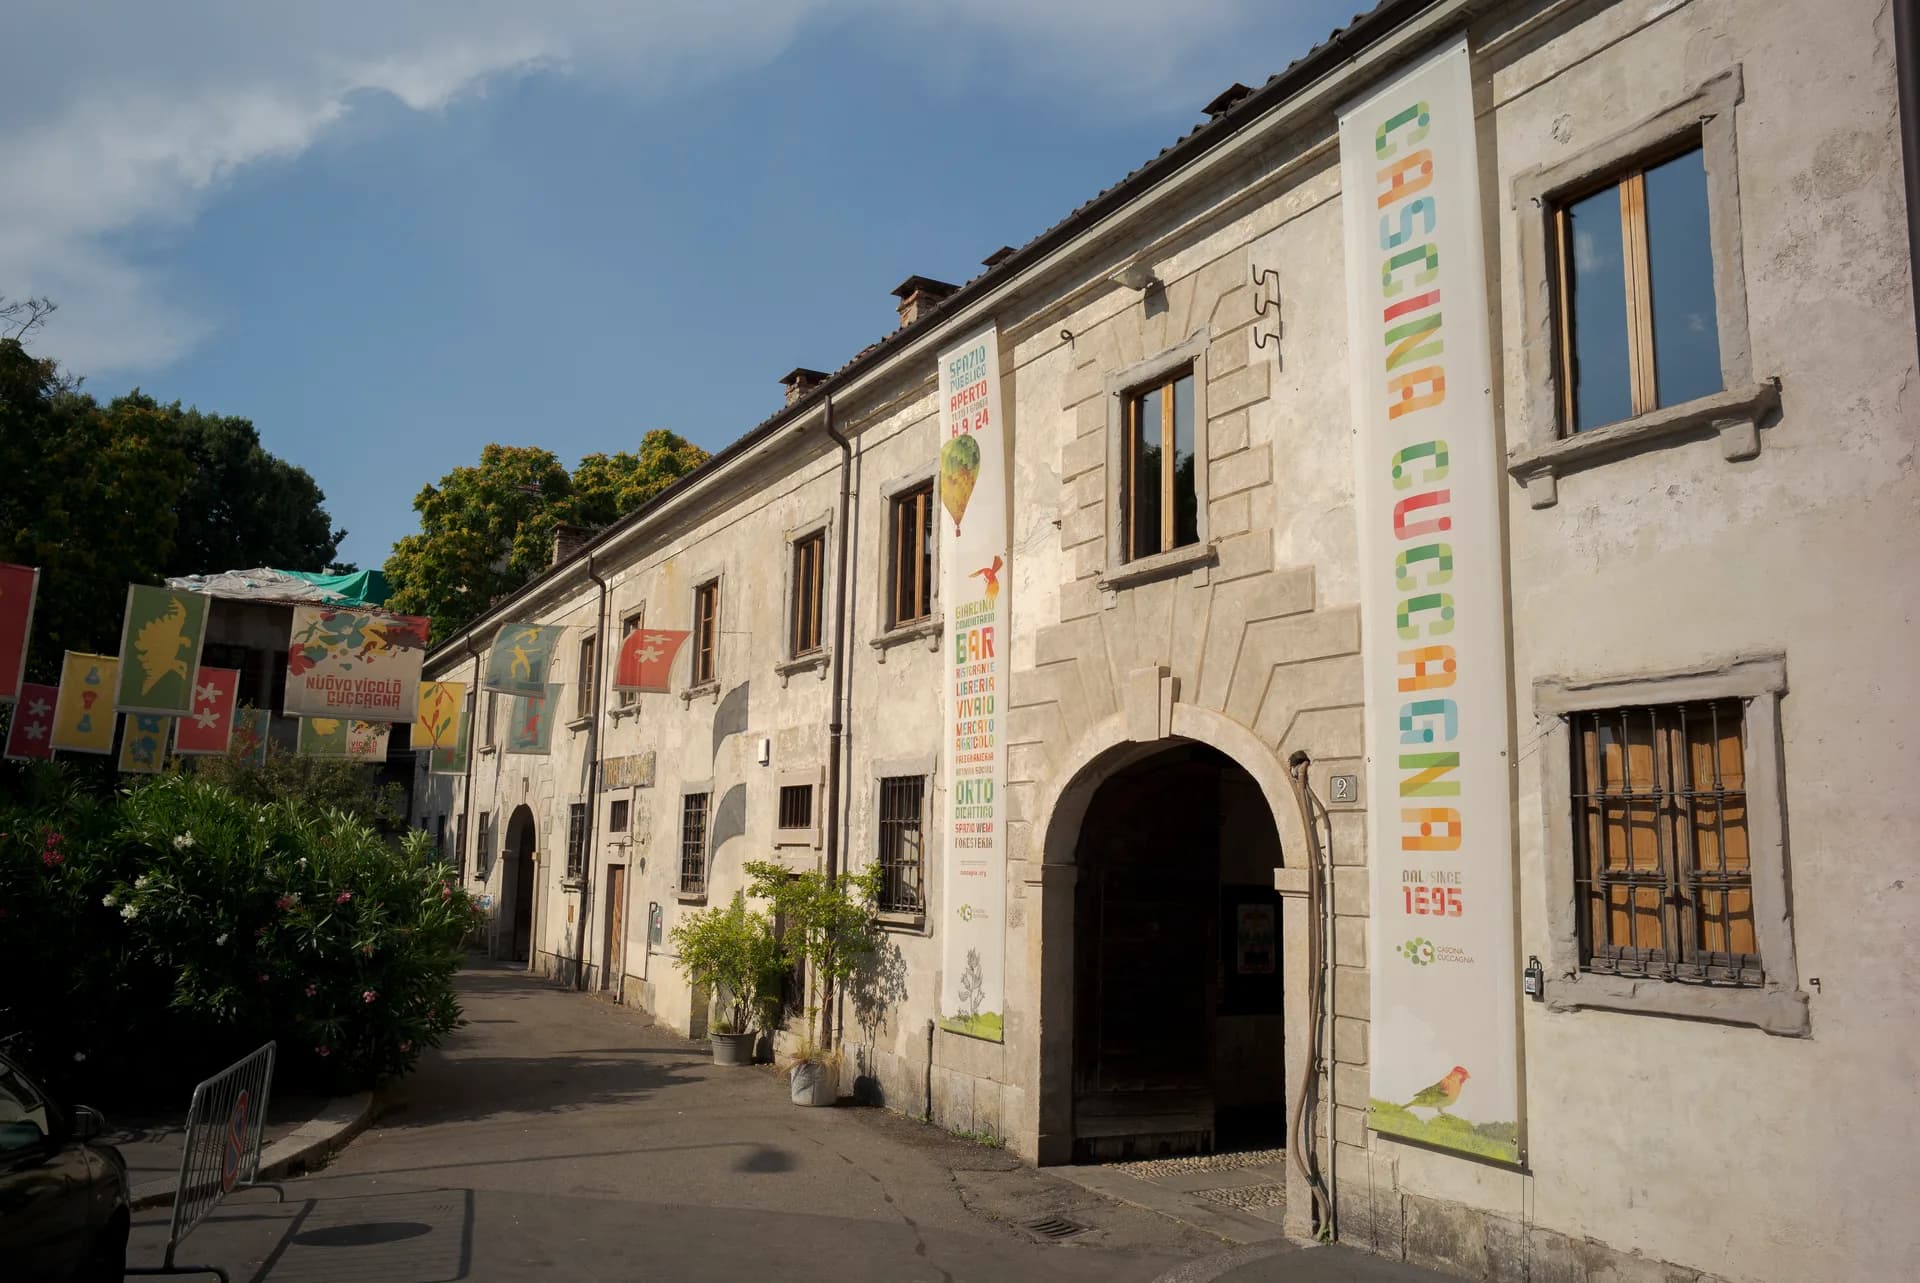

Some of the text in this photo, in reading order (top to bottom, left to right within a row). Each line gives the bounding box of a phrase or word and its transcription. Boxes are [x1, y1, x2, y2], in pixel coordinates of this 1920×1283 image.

[1376, 100, 1446, 421] CASCINA
[951, 379, 987, 412] APERTO
[956, 626, 995, 664] BAR
[1392, 439, 1462, 851] CUCCAGNA
[956, 676, 995, 697] LIBRERIA
[956, 695, 994, 718] VIVAIO
[956, 719, 994, 737] MERCATO
[956, 779, 994, 805] ORTO
[1336, 778, 1347, 799] 2
[1402, 869, 1462, 885] DAL SINCE
